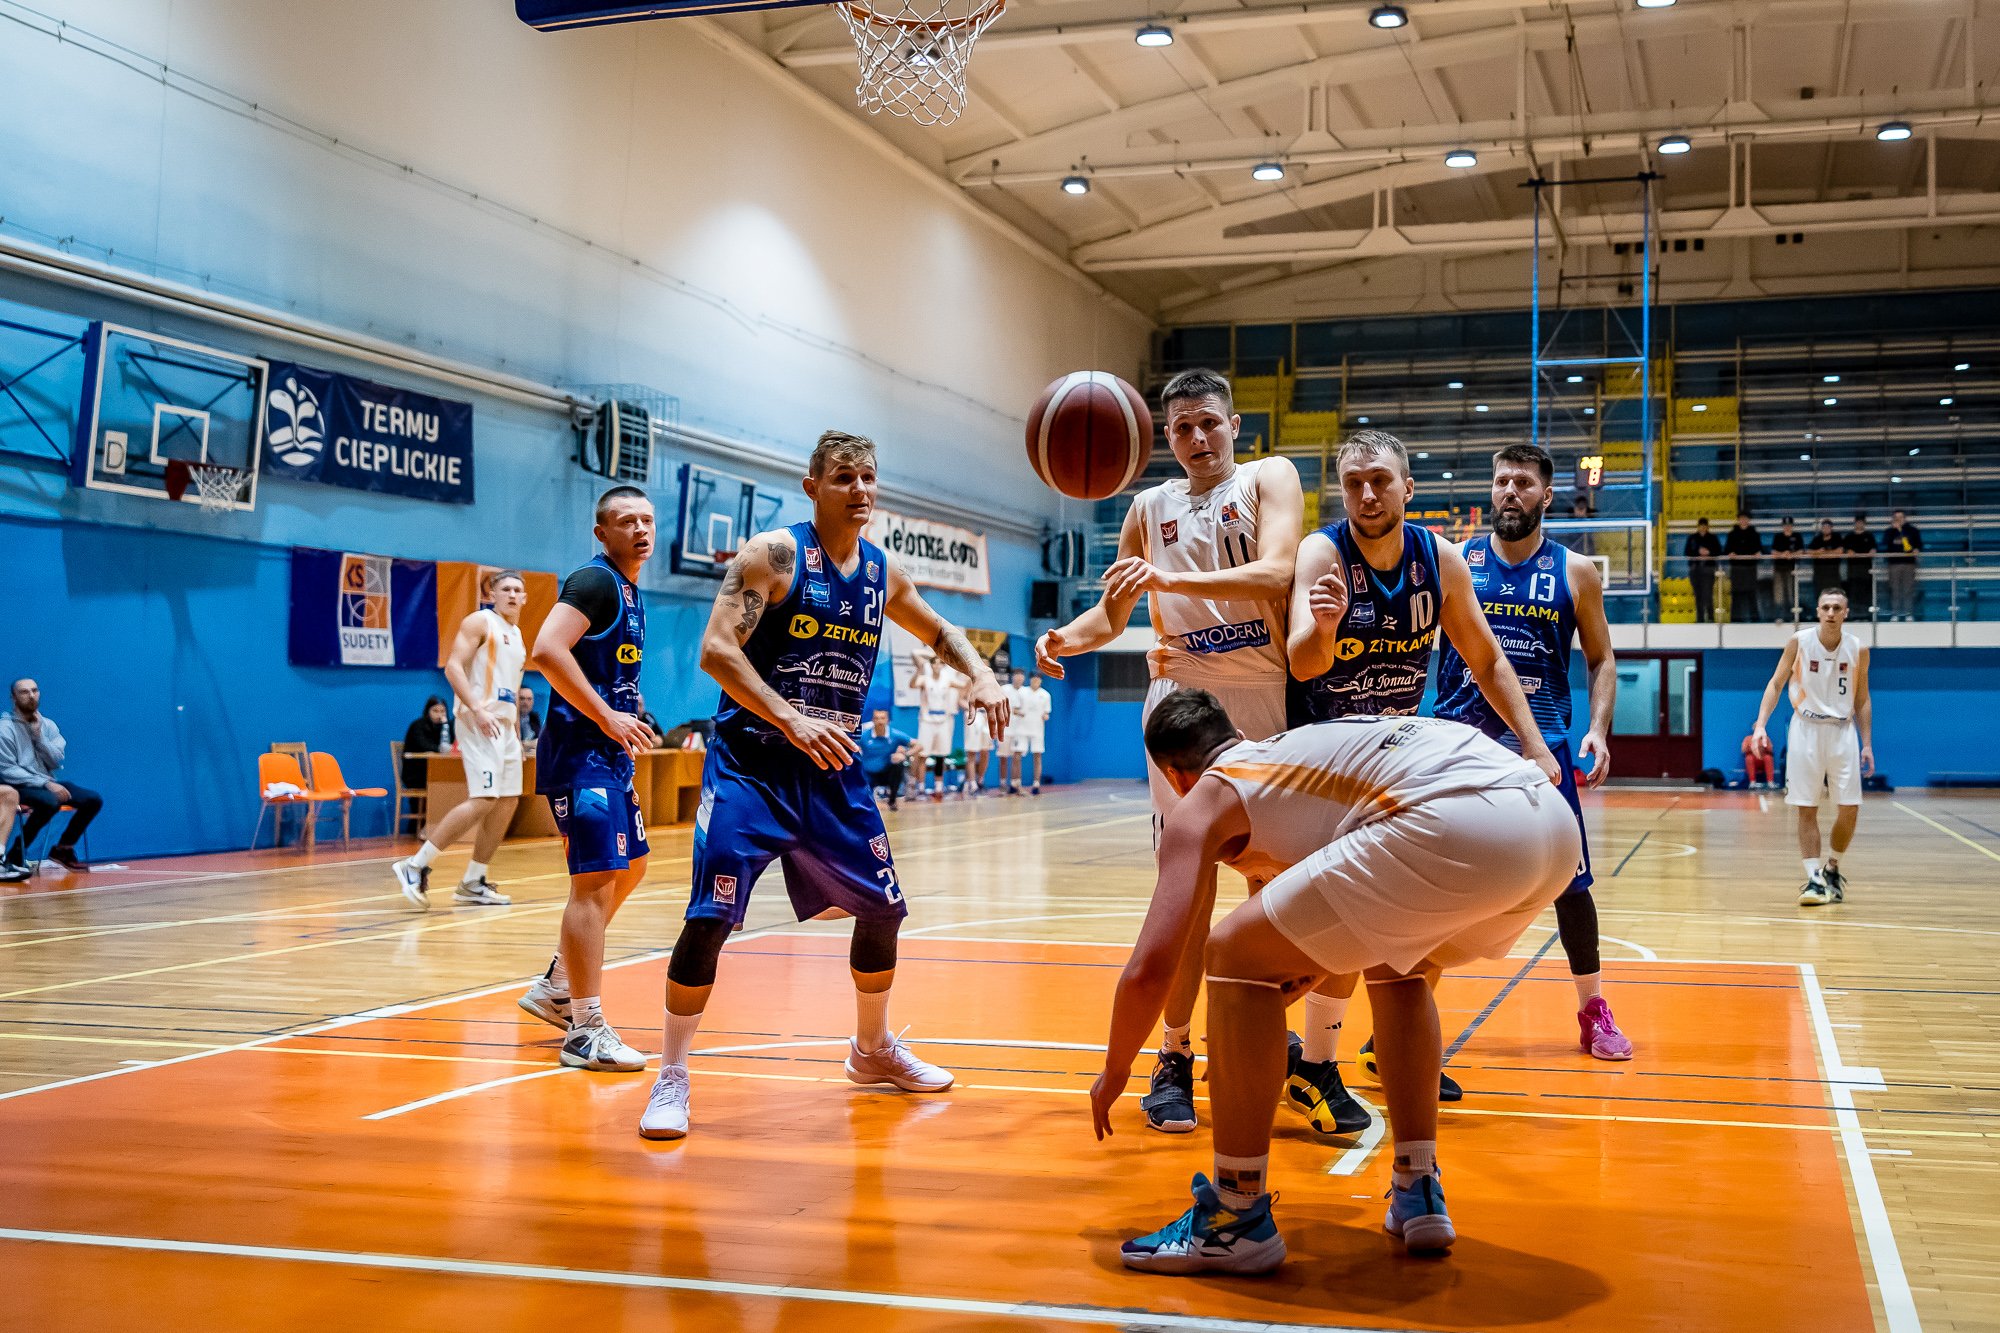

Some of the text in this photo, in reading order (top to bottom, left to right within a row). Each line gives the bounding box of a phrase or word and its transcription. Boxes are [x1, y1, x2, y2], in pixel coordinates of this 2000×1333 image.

[360, 400, 439, 443] TERMY
[335, 436, 462, 486] CIEPLICKIE
[1528, 572, 1556, 603] 13
[863, 586, 885, 628] 21
[1409, 590, 1434, 633] 10
[1482, 601, 1560, 624] ZETKAMA
[342, 632, 389, 650] SUDETY
[793, 618, 878, 648] K ZETKAM
[1191, 622, 1268, 649] MODERN
[620, 647, 635, 660] K
[1340, 642, 1358, 656] K
[810, 660, 825, 676] La
[1361, 675, 1375, 691] La
[1838, 677, 1848, 696] 5
[483, 770, 493, 789] 3
[634, 810, 646, 842] 8
[876, 866, 903, 905] 2
